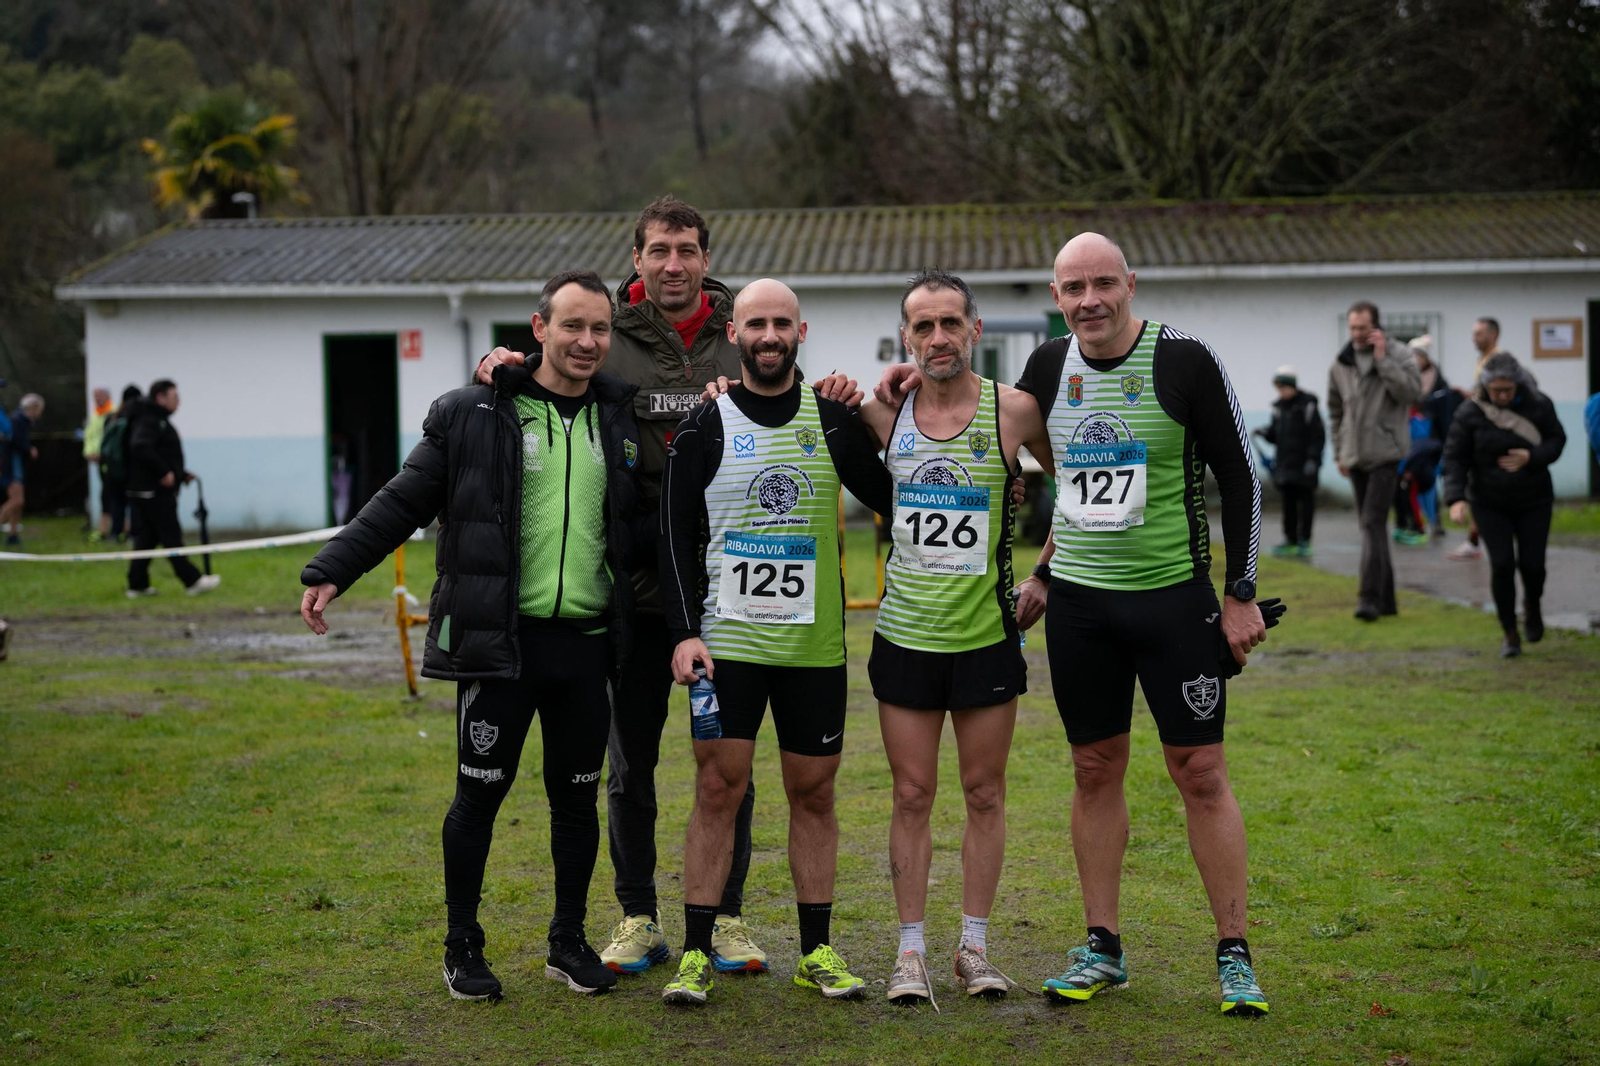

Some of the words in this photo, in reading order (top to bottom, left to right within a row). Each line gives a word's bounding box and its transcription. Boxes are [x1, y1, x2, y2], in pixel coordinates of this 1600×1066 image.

[1118, 449, 1144, 461] 2026
[899, 492, 957, 505] RIBADAVIA
[960, 496, 988, 507] 2026
[1071, 469, 1135, 505] 127
[905, 512, 978, 549] 126
[726, 540, 786, 555] RIBADAVIA
[788, 545, 814, 555] 2026
[732, 562, 805, 598] 125
